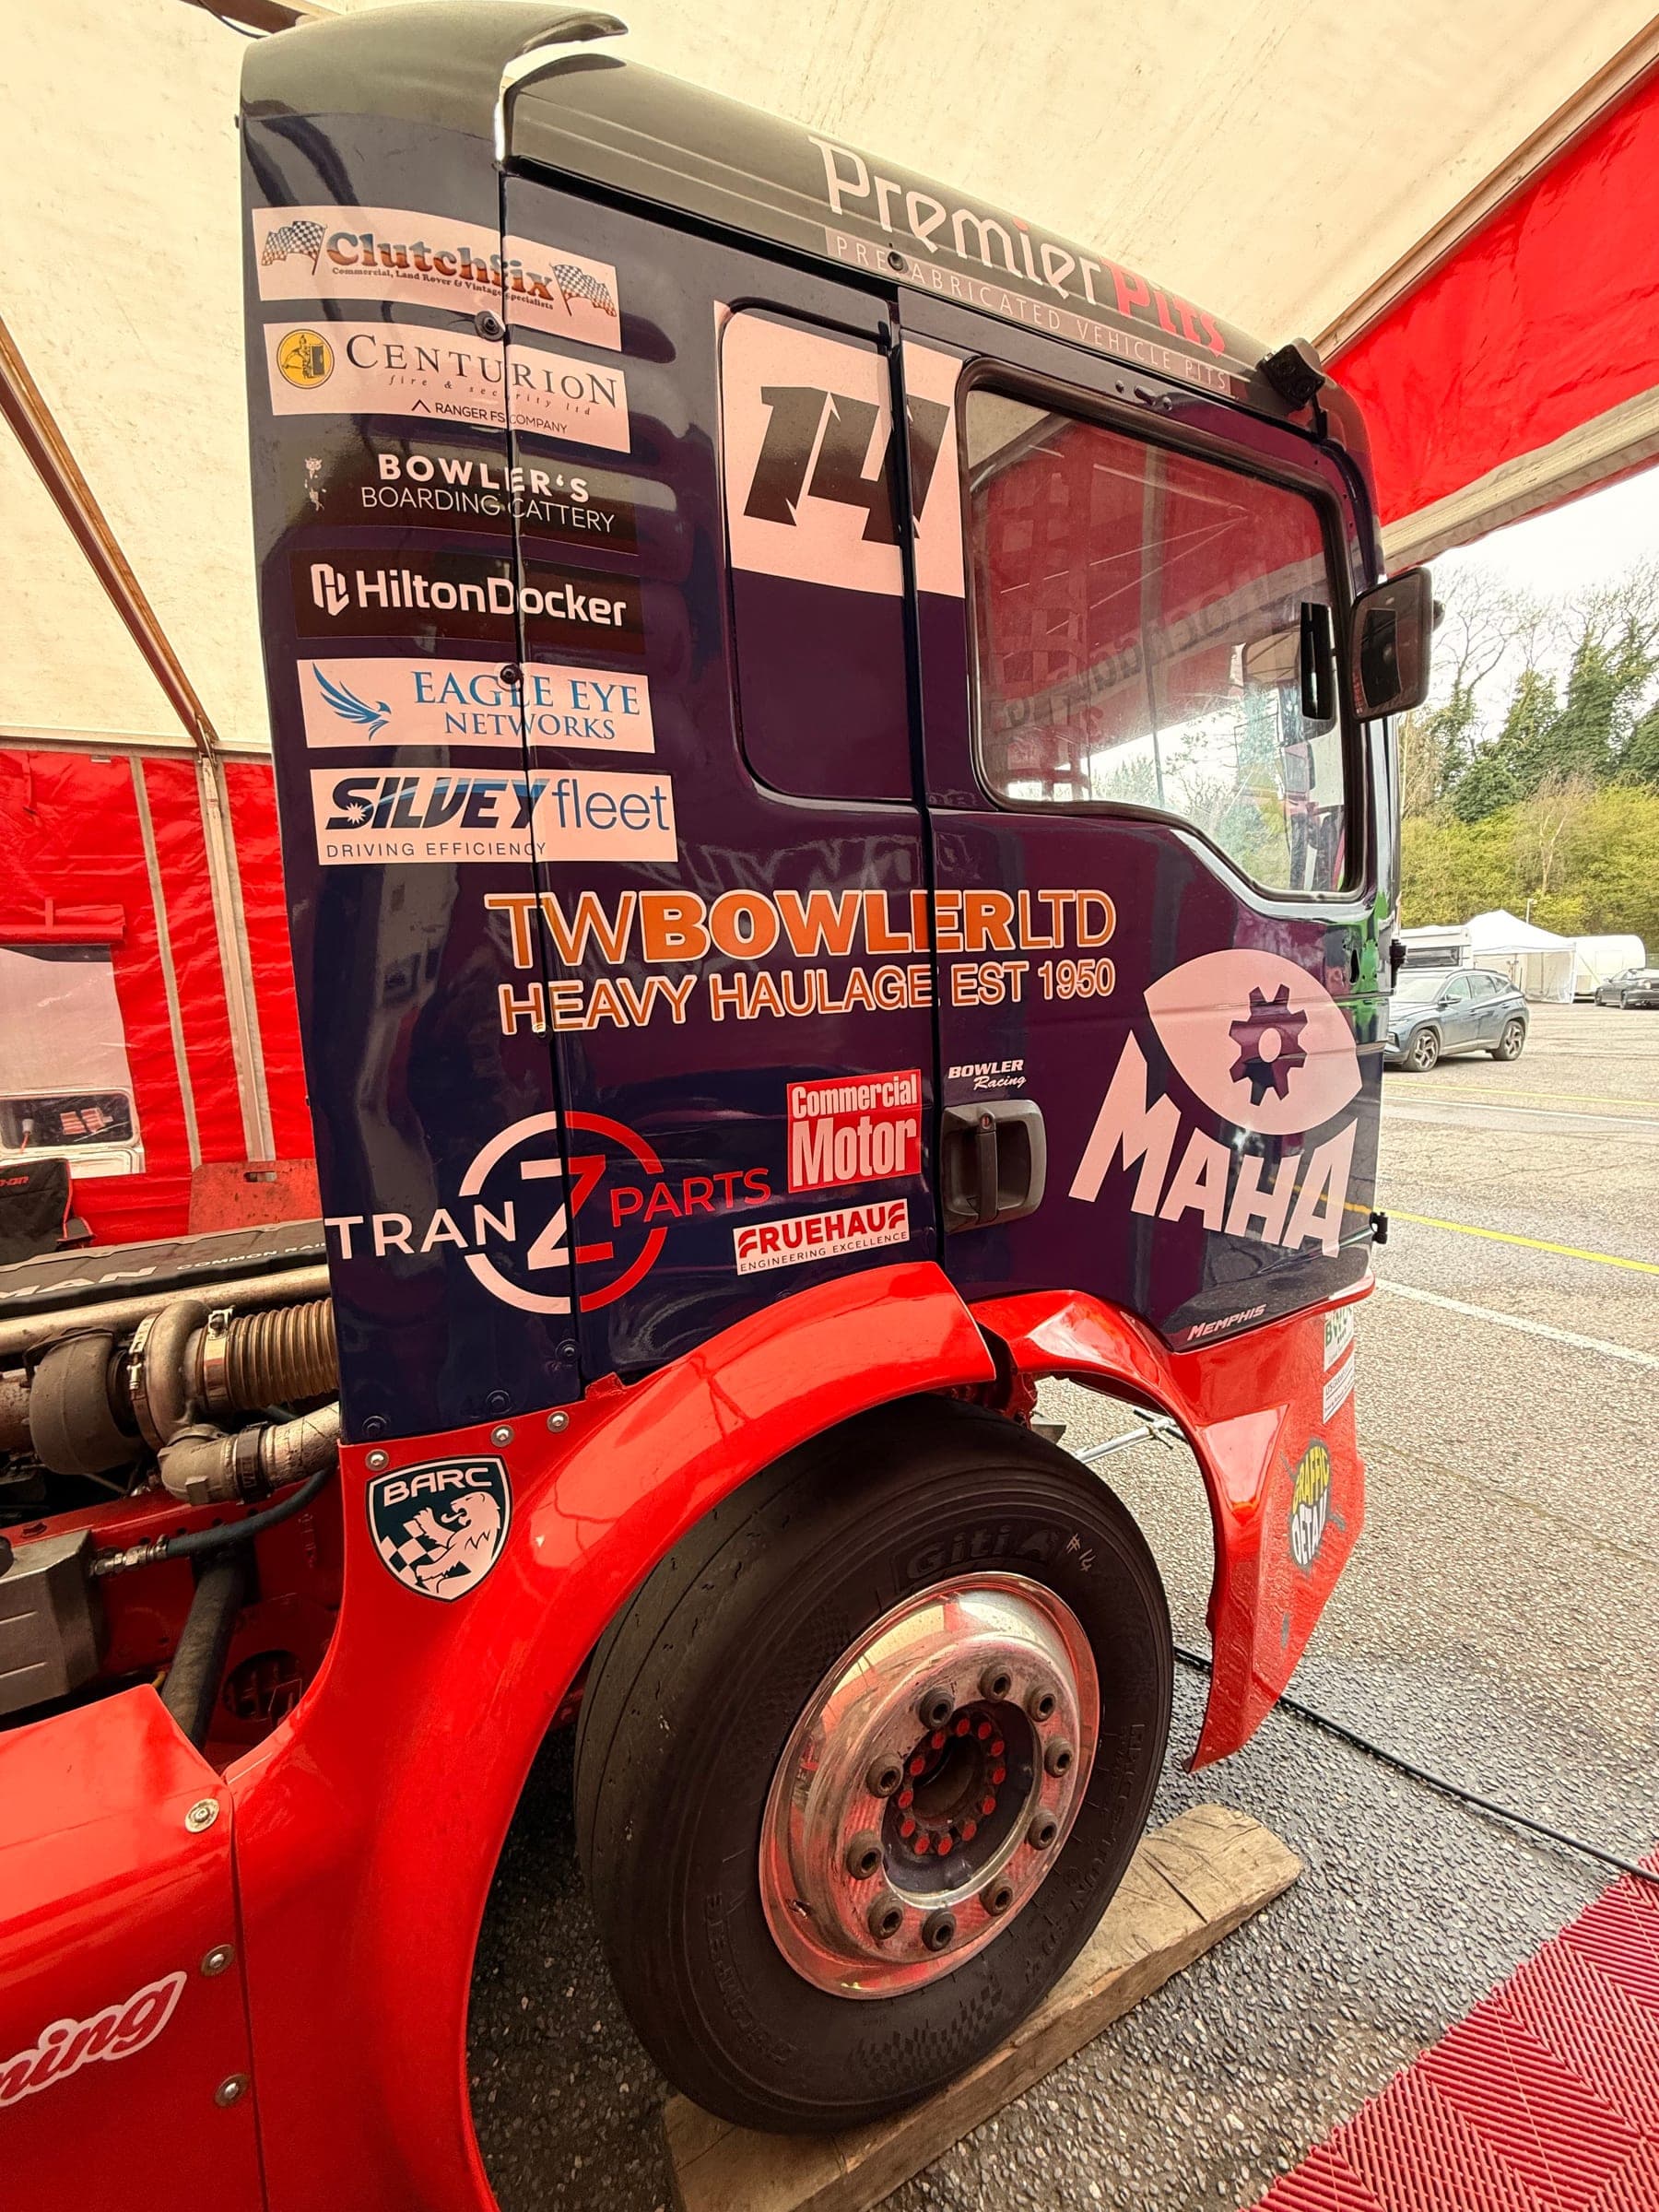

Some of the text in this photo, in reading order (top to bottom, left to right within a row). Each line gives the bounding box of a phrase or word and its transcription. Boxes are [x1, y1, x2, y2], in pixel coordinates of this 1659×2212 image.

[326, 231, 555, 300] Clutchfix
[332, 266, 394, 279] Commercial,
[395, 270, 420, 281] Land
[422, 273, 453, 286] Rover
[465, 281, 502, 297] Vintage
[504, 291, 554, 311] Specialists
[836, 236, 1228, 391] PREABRICATED VEHICLE PITS
[389, 375, 591, 416] fire & secrity ltd
[435, 402, 568, 434] RANGER FS COMPANY
[743, 385, 950, 547] 14
[361, 487, 616, 534] BOARDING CATTERY
[357, 569, 628, 627] HiltonDocker
[411, 671, 641, 716] EAGLE EYE
[444, 712, 617, 741] NETWORKS
[326, 841, 547, 858] DRIVING EFFICIENCY
[498, 959, 1116, 1036] HEAVY HAULAGE EST 1950
[947, 1059, 1024, 1079] BOWLER
[972, 1075, 1028, 1091] Racing
[791, 1074, 919, 1120] Commercial
[791, 1112, 919, 1189] Motor
[1068, 1030, 1358, 1258] MAHA
[610, 1167, 772, 1228] PARTS
[177, 1251, 278, 1272] COMMON
[740, 1231, 908, 1272] ENGINEERING EXCELLENCE
[383, 1467, 492, 1508] BARC
